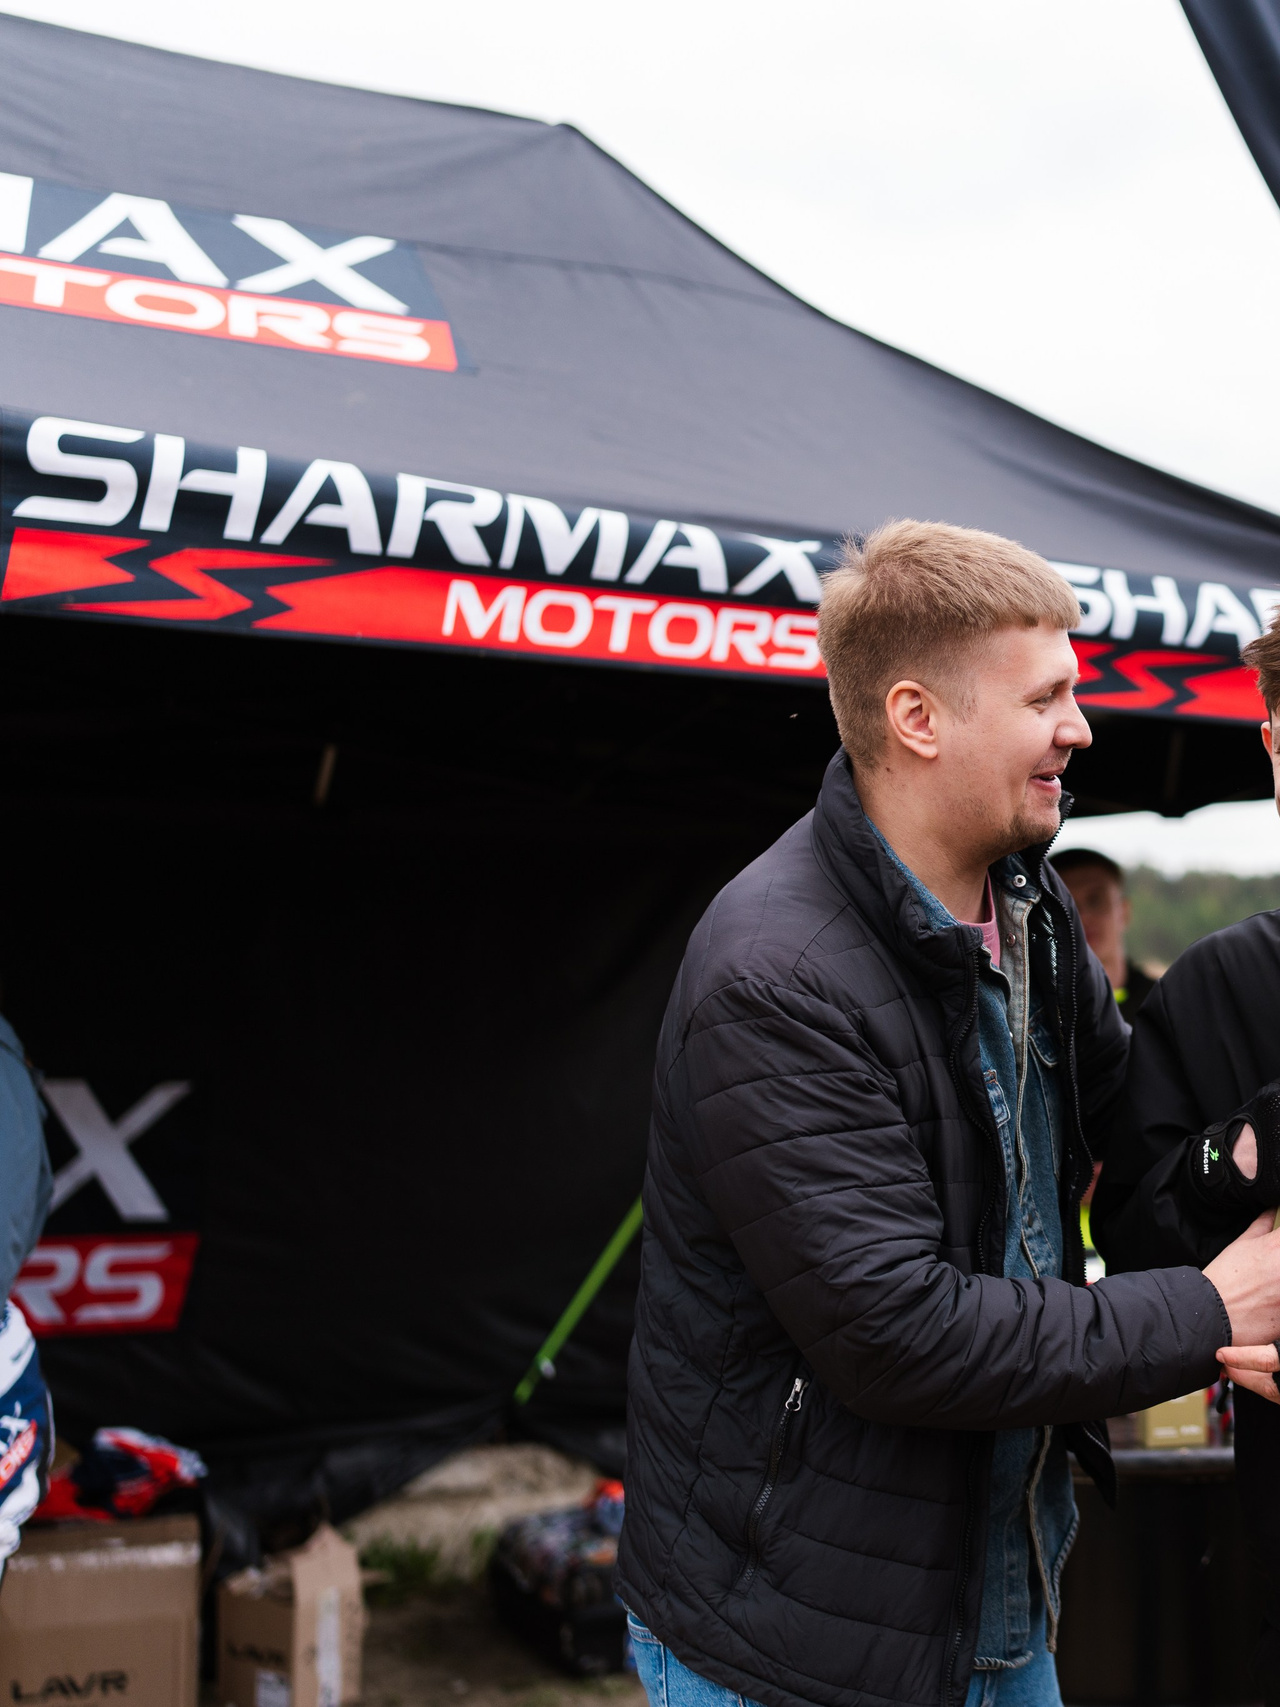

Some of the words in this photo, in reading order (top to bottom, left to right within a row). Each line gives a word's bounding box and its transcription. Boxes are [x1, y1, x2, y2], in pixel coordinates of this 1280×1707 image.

[0, 172, 410, 316] AX
[12, 416, 823, 603] SHARMAX
[442, 578, 823, 671] MOTORS
